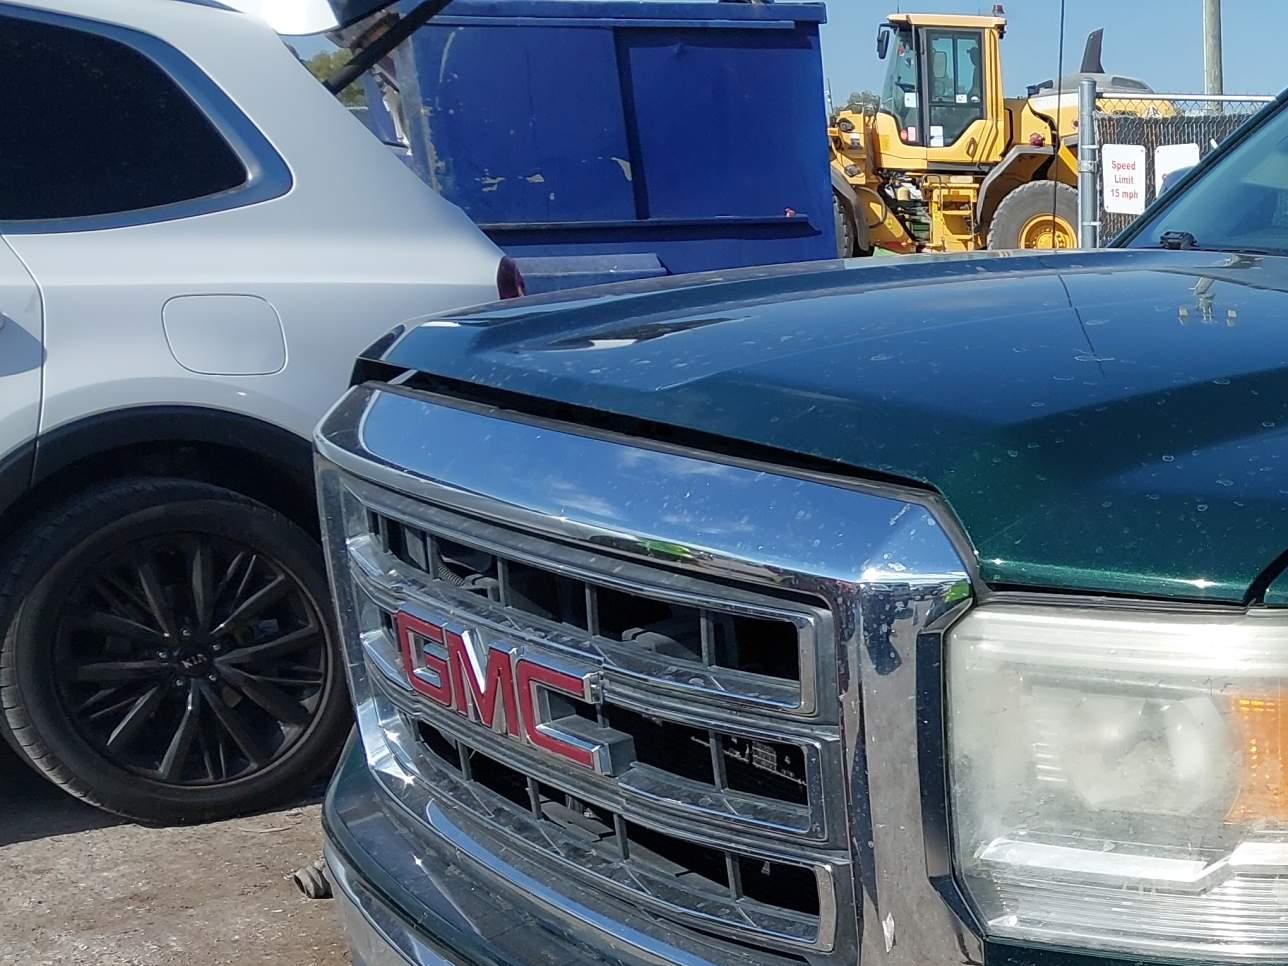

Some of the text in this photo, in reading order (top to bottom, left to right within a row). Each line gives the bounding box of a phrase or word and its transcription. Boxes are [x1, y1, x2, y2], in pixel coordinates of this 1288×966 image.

[1111, 160, 1137, 171] Speed
[1114, 175, 1134, 185] Limit
[1110, 188, 1139, 200] 15 mph
[397, 604, 606, 774] GMC
